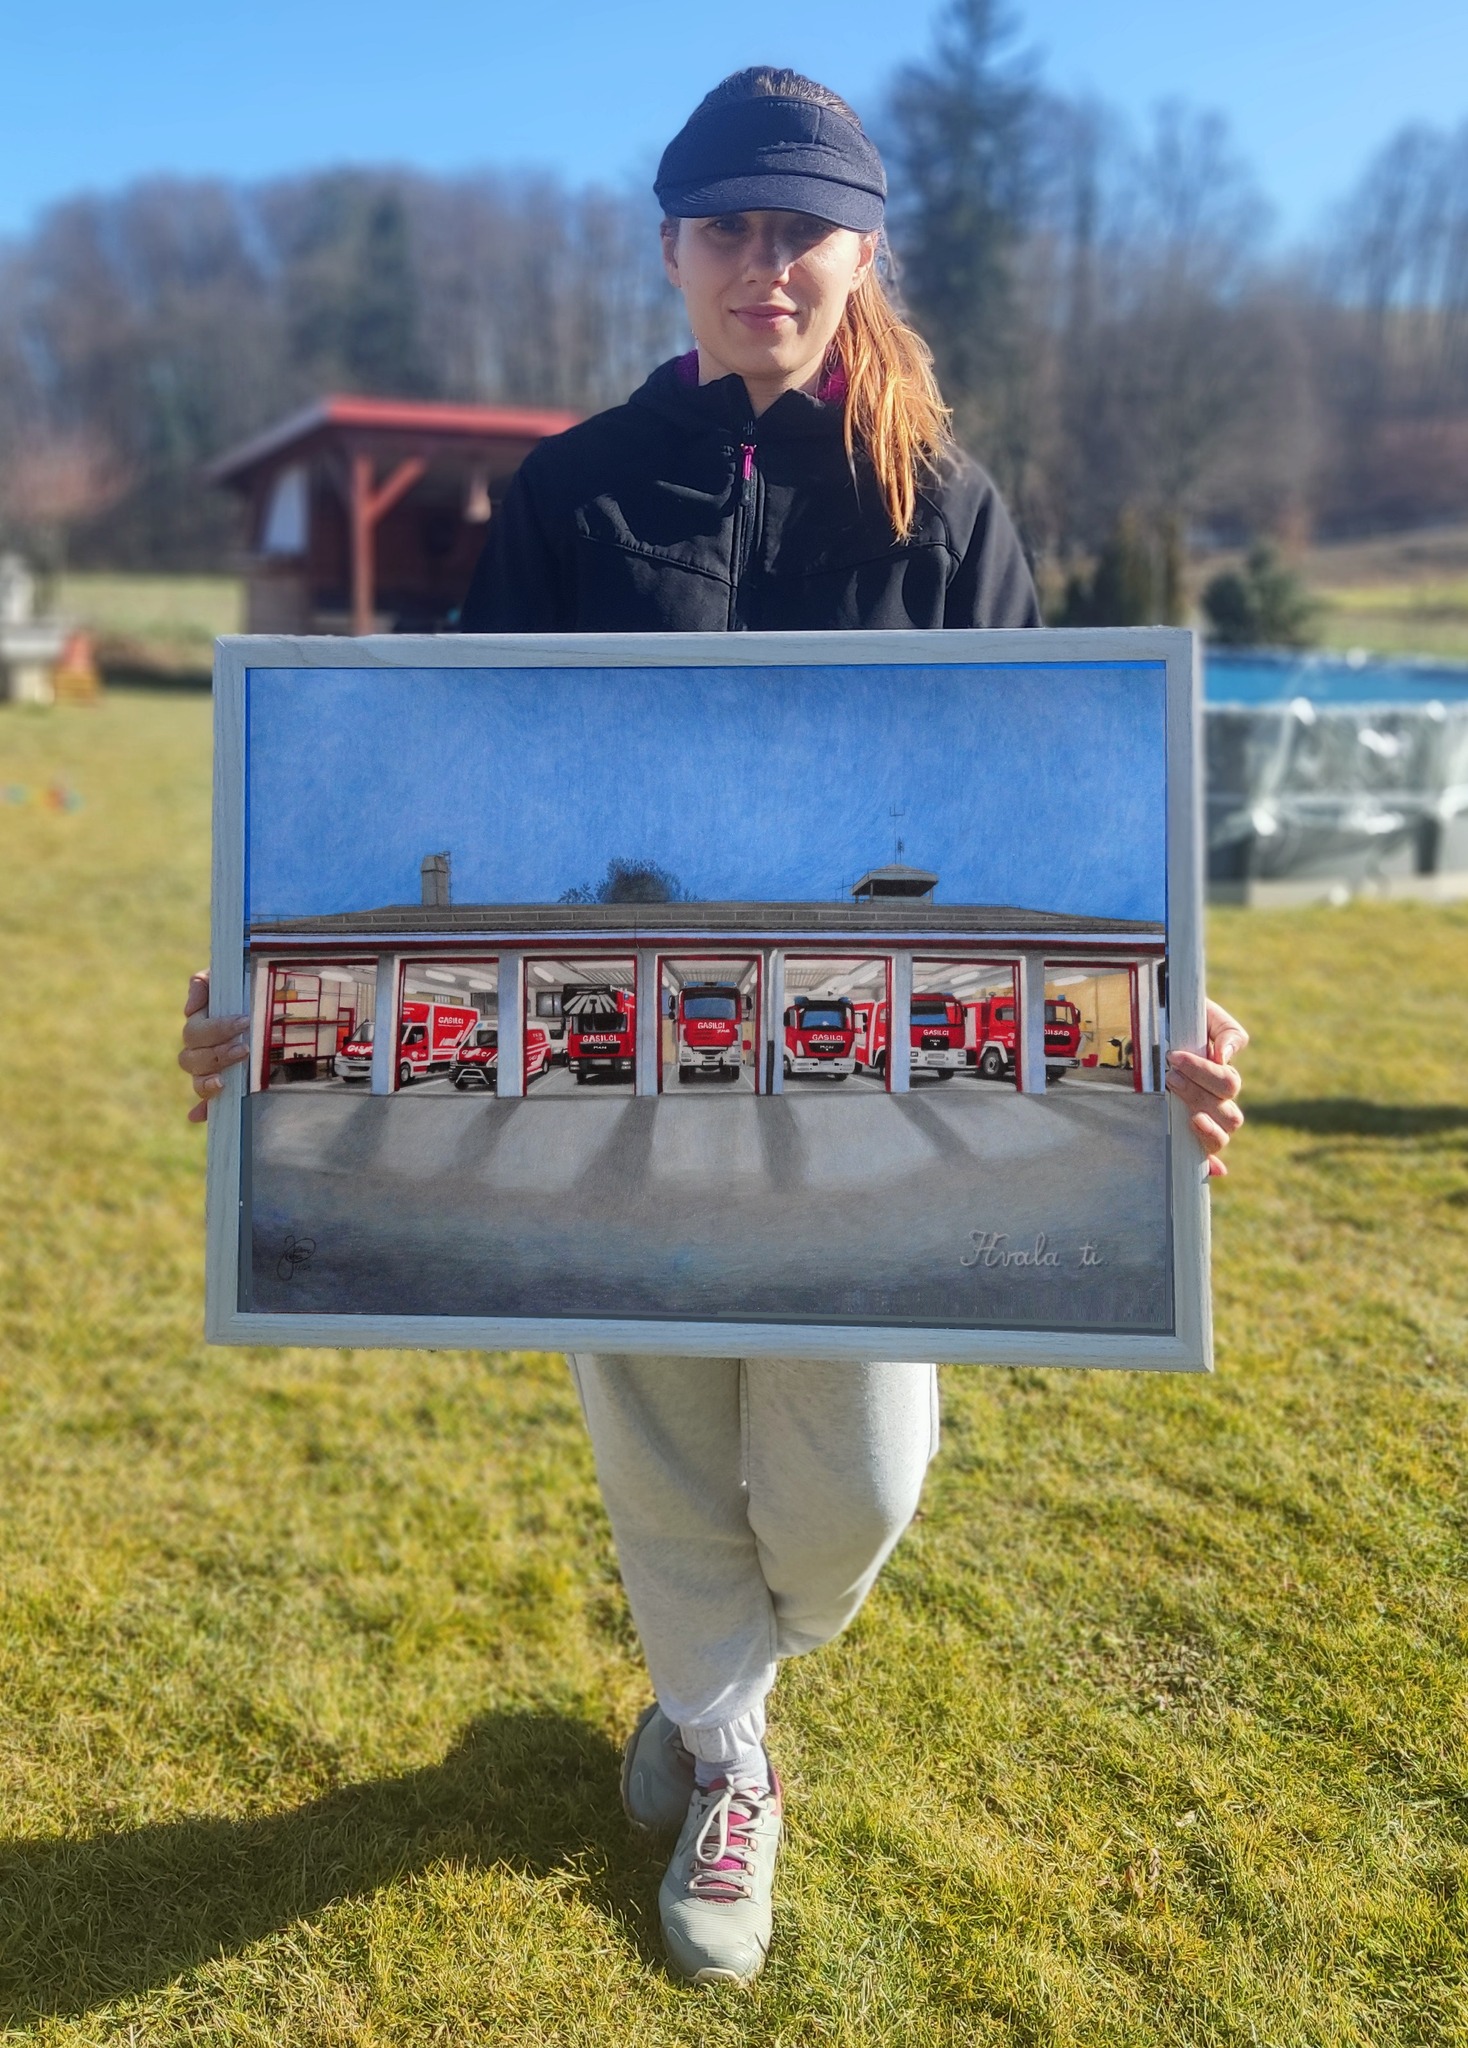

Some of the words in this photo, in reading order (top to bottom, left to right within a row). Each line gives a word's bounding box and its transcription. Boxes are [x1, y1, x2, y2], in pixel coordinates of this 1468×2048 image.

[697, 1021, 726, 1030] GASILCI
[811, 1033, 844, 1041] GASILCI
[922, 1029, 950, 1037] GASILCI
[582, 1034, 617, 1043] GASILCI
[960, 1229, 1060, 1267] Hvala
